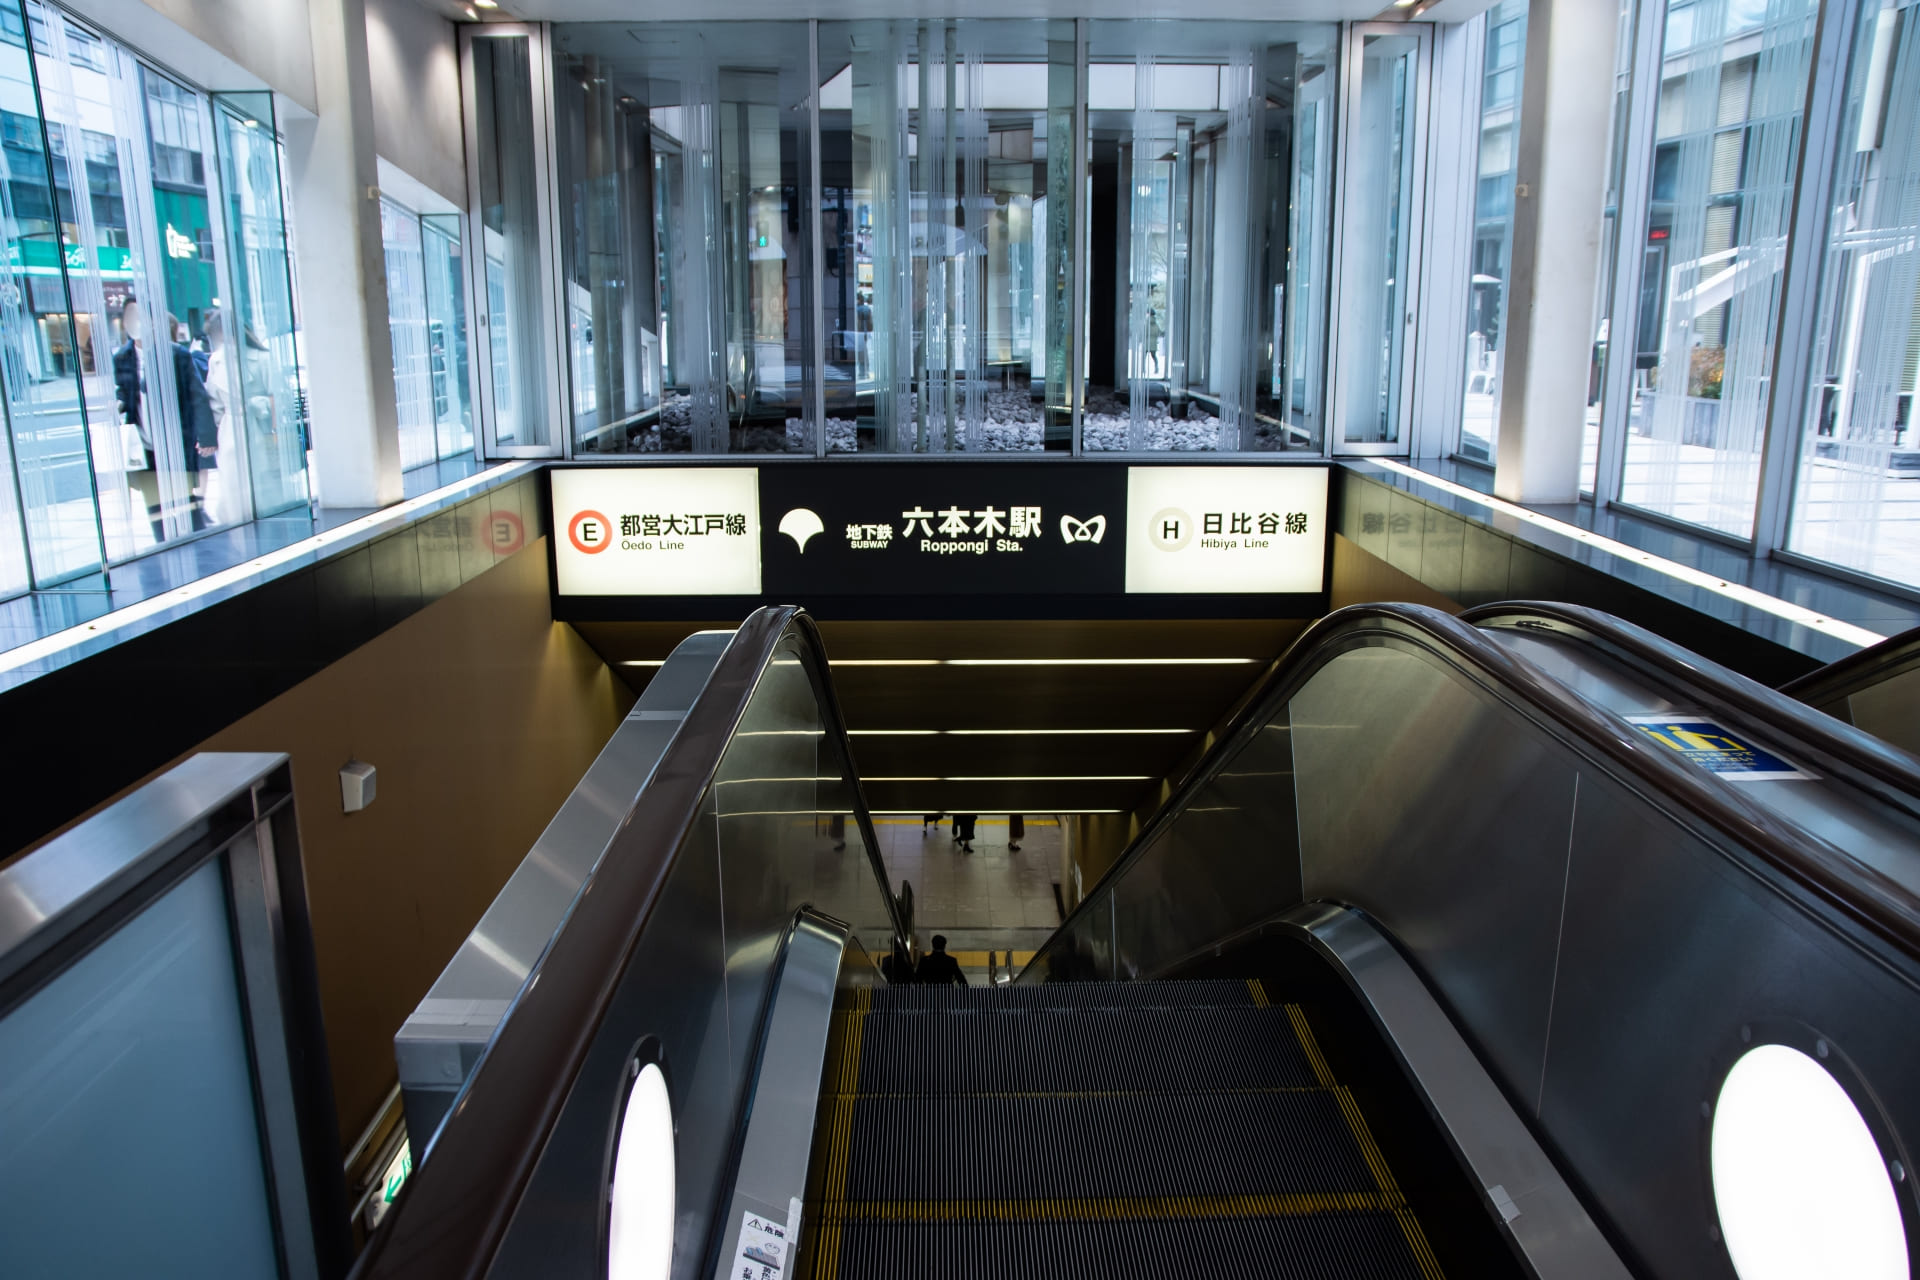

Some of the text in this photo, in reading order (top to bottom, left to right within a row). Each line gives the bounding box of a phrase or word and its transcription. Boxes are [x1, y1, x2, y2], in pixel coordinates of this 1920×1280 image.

[620, 513, 747, 537] 都営大江戸線
[902, 505, 1042, 539] 六本木駅
[1163, 520, 1179, 540] H
[1203, 512, 1308, 535] 日比谷線
[583, 523, 598, 542] E
[845, 523, 893, 541] 地下鉄
[621, 540, 685, 550] Oedo Line
[850, 540, 889, 549] SUBWAY
[920, 539, 1024, 555] Roppongi Sta.
[1200, 538, 1269, 551] Hibiya Line
